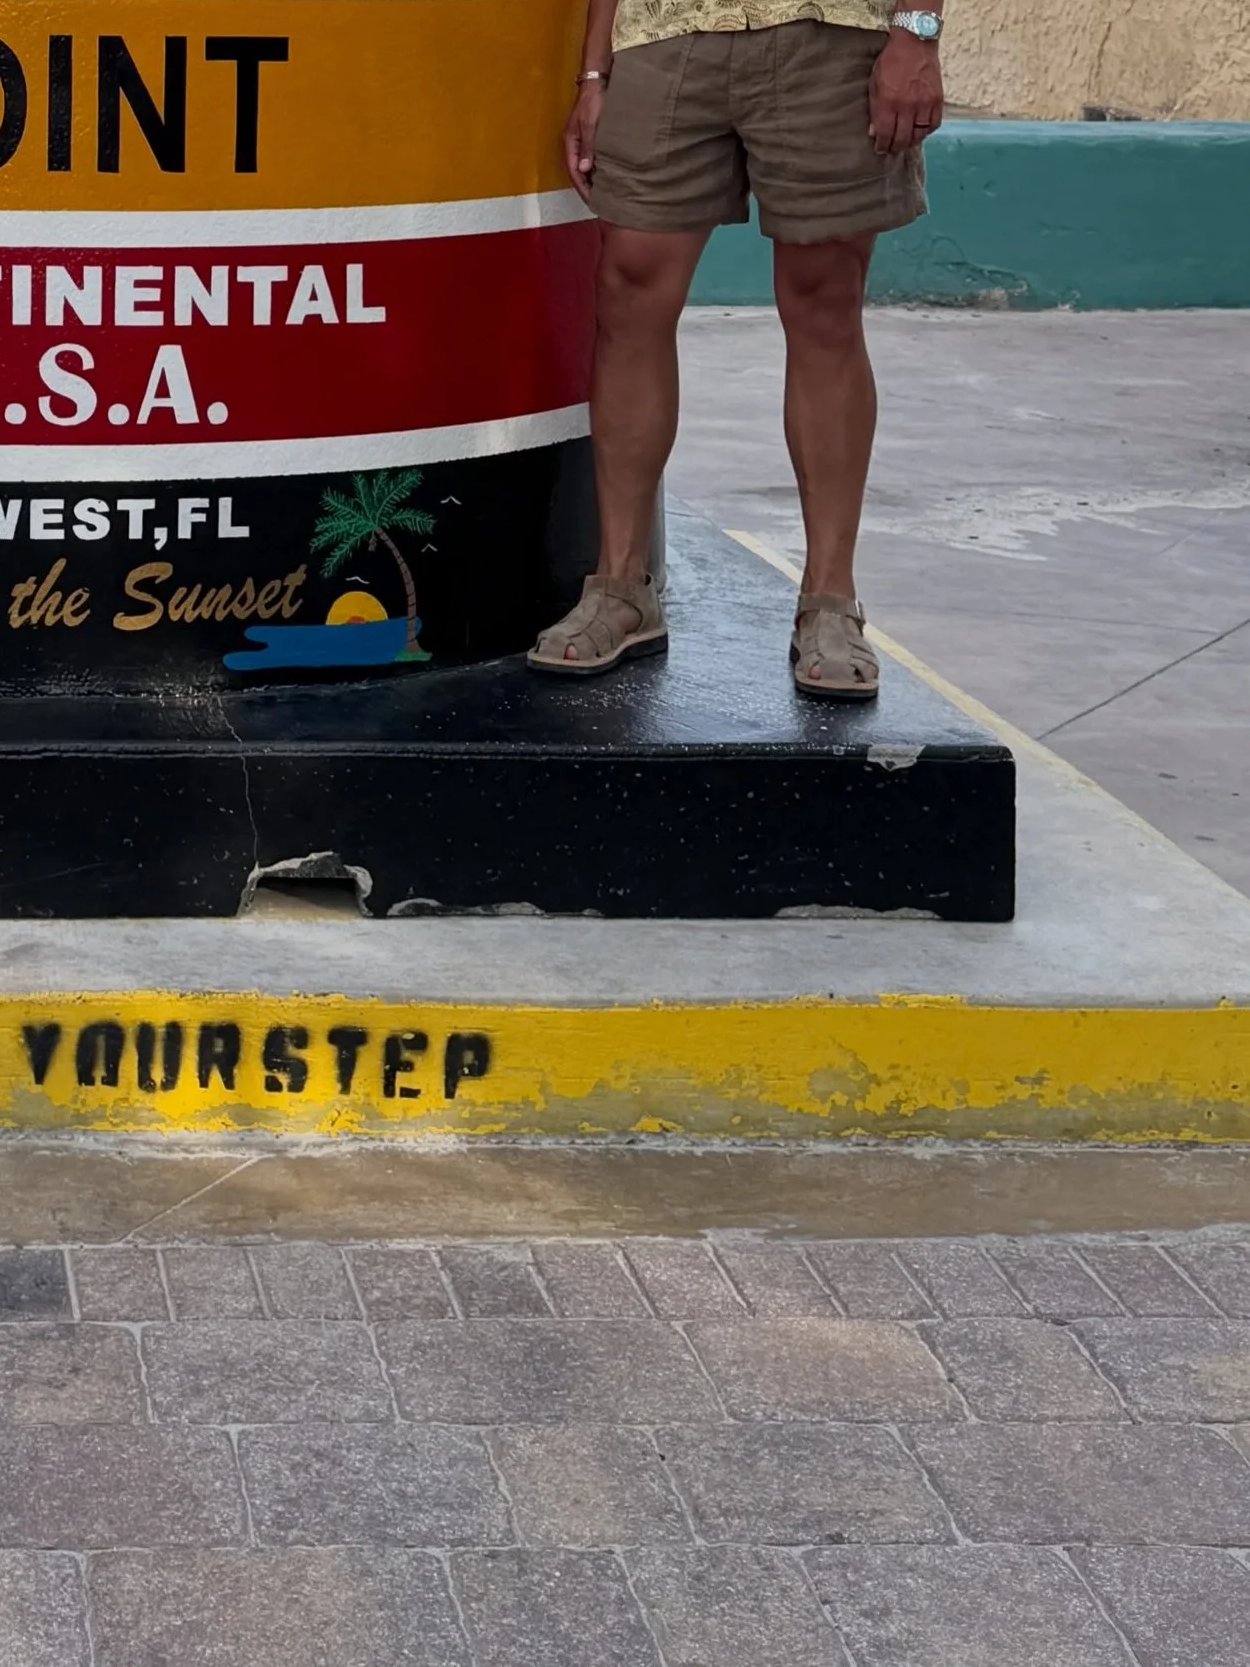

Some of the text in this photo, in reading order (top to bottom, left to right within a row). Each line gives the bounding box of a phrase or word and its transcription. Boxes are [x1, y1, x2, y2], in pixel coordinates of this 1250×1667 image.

[8, 557, 91, 627] the
[112, 563, 308, 632] Sunset
[19, 1019, 241, 1092] YOUR
[261, 1024, 493, 1100] STEP
